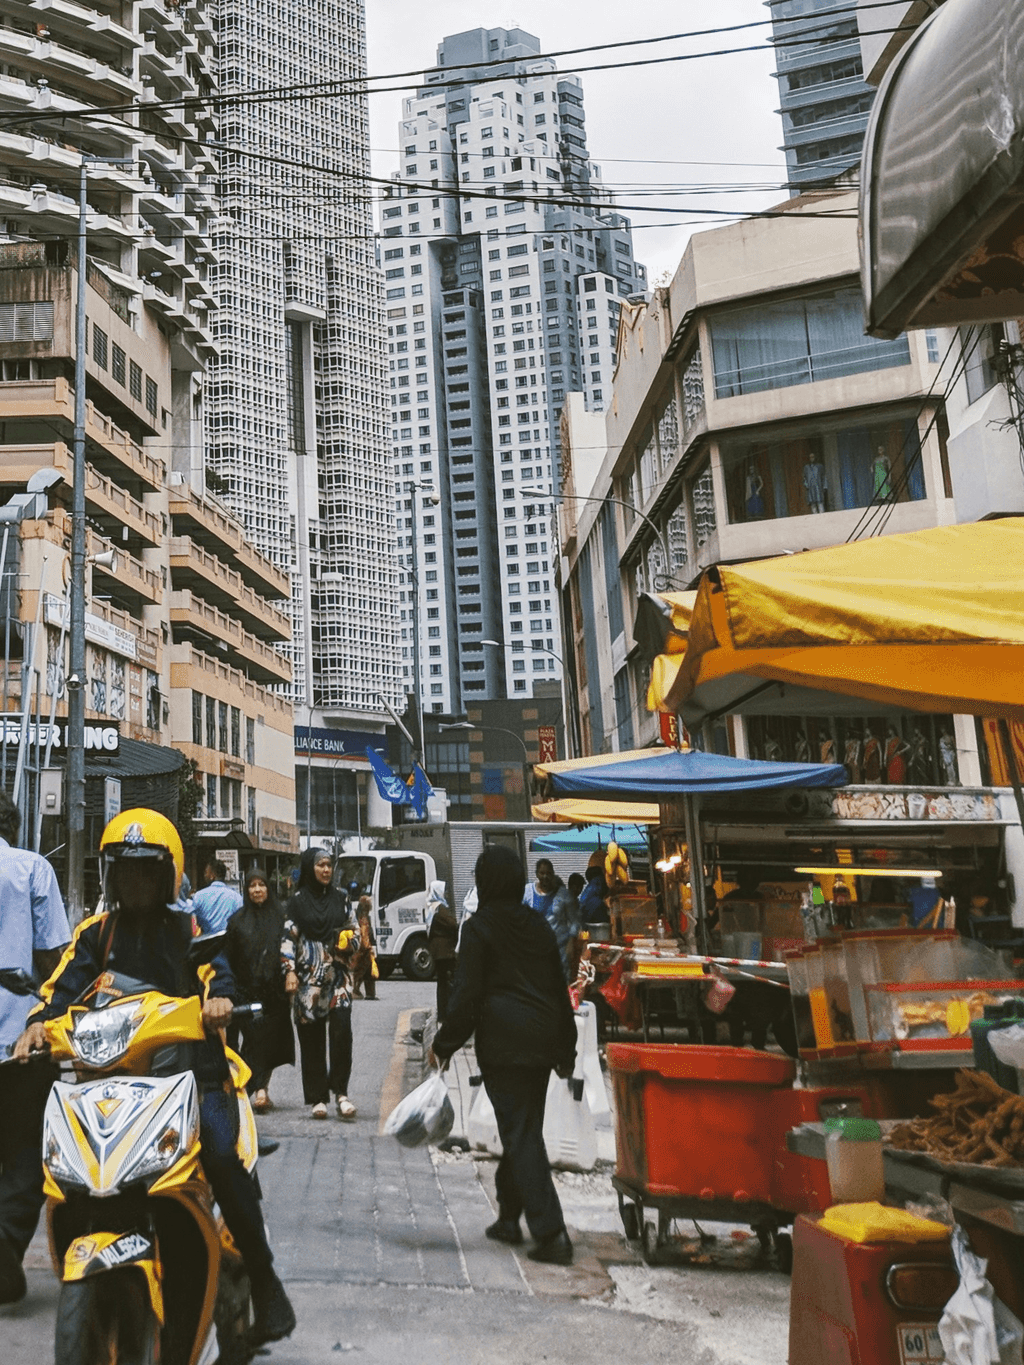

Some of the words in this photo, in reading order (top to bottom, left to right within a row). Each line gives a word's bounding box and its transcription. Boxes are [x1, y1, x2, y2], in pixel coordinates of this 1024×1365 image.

[293, 736, 322, 750] LIANCE
[324, 739, 345, 753] BANK
[905, 1335, 923, 1352] 60
